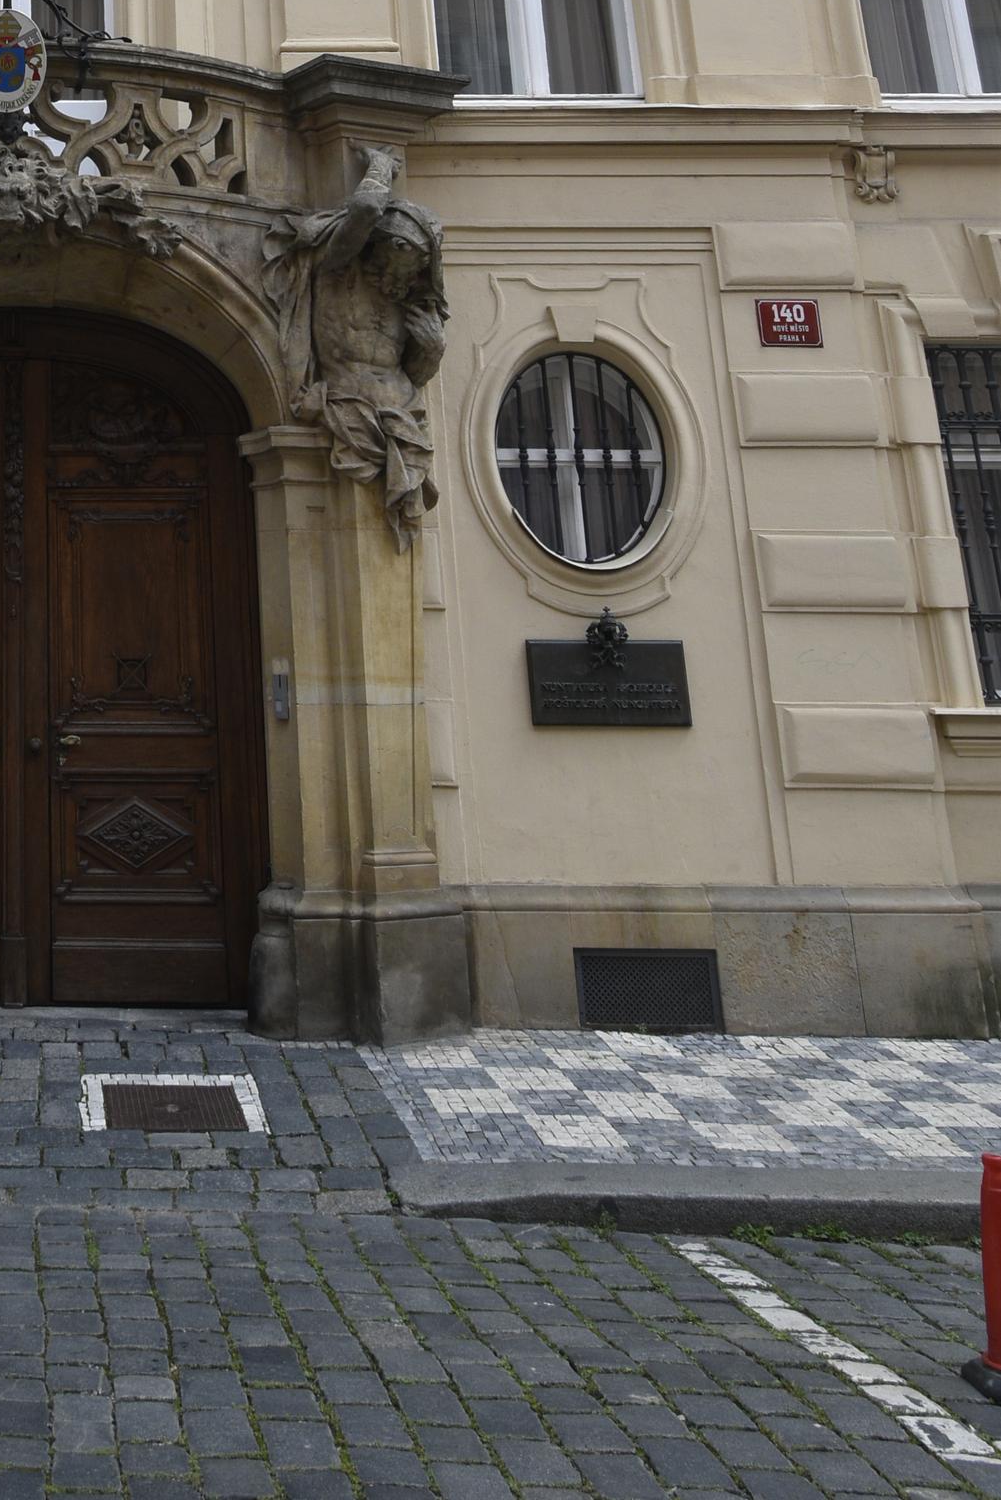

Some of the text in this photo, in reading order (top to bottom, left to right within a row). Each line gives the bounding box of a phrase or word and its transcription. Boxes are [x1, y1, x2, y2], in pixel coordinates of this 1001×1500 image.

[772, 304, 805, 322] 140
[772, 324, 809, 332] NOVÉ MĚSTO
